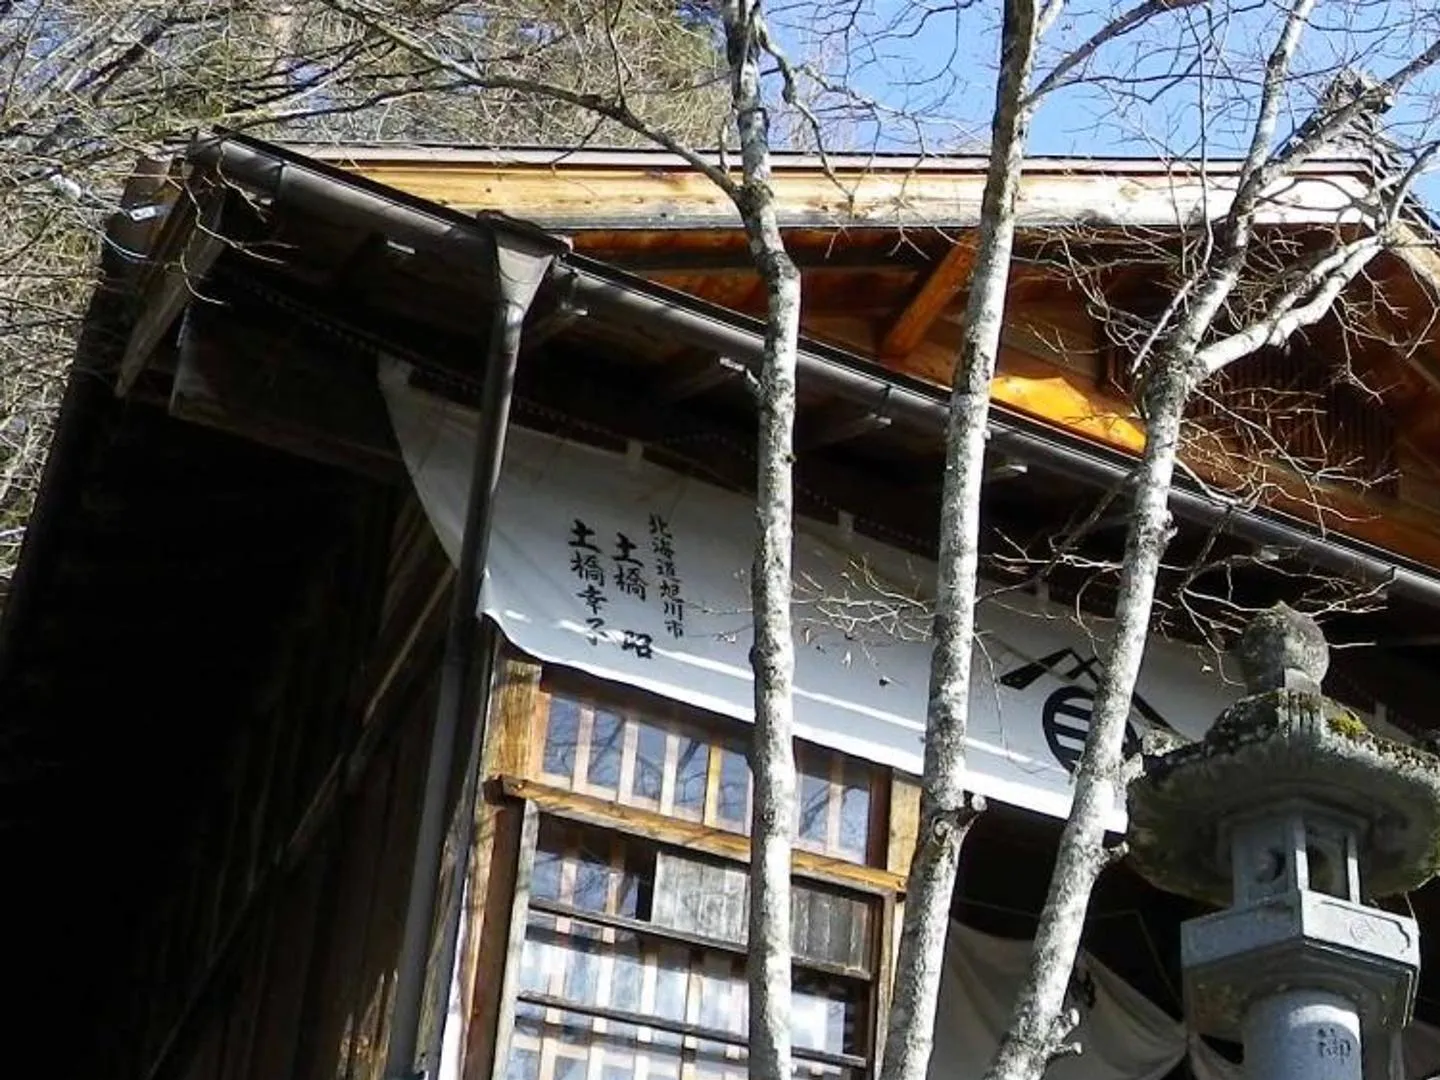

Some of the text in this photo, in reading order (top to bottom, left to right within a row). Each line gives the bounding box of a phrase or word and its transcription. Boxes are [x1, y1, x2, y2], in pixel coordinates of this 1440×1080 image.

[567, 518, 608, 646] 土橋幸子
[649, 512, 686, 639] 北海道旭川市
